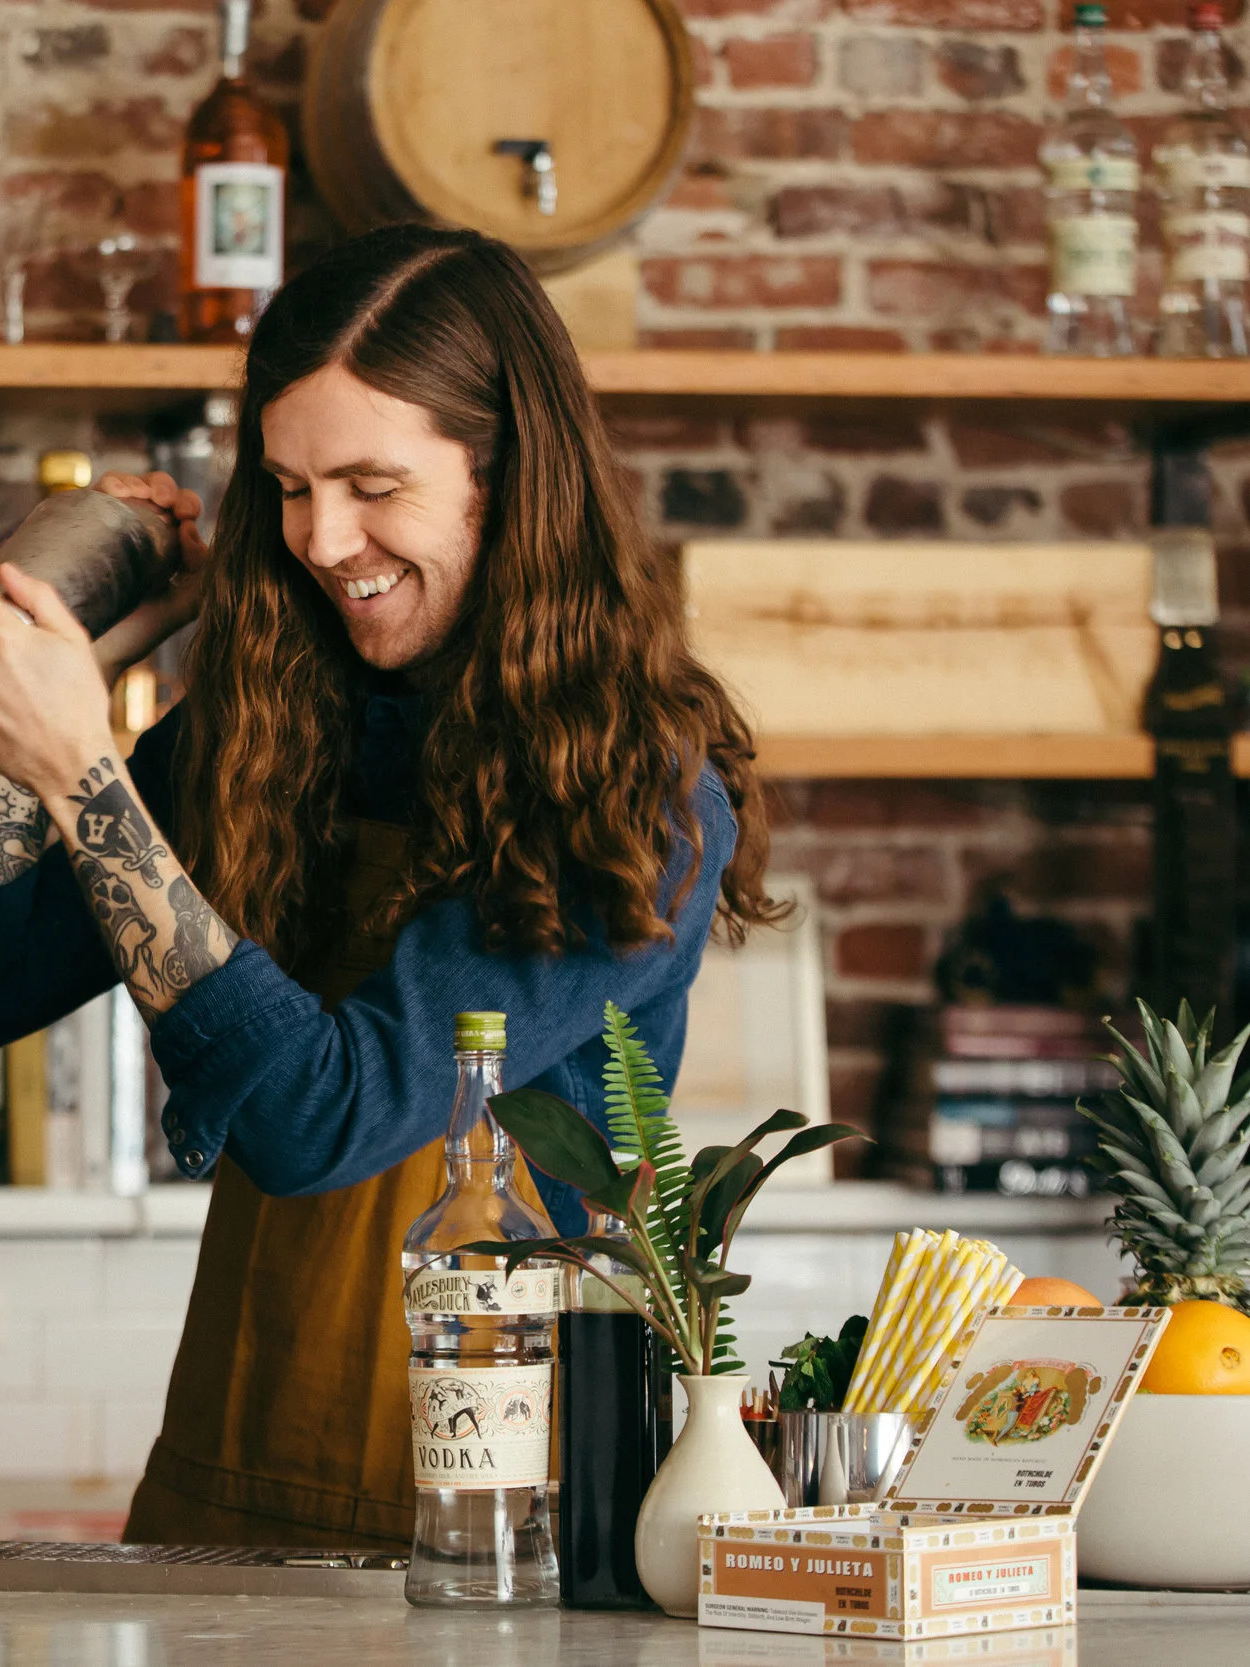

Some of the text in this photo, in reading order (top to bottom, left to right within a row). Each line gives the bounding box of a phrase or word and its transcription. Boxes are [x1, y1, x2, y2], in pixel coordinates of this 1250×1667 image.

[439, 1292, 471, 1312] DUCK
[418, 1445, 496, 1469] VODKA
[1015, 1469, 1054, 1479] ROTHCHILDE
[1013, 1479, 1046, 1489] EN TUBOS
[725, 1553, 874, 1578] ROMEO Y JULIETA
[948, 1565, 1034, 1584] ROMEO Y JULIETA
